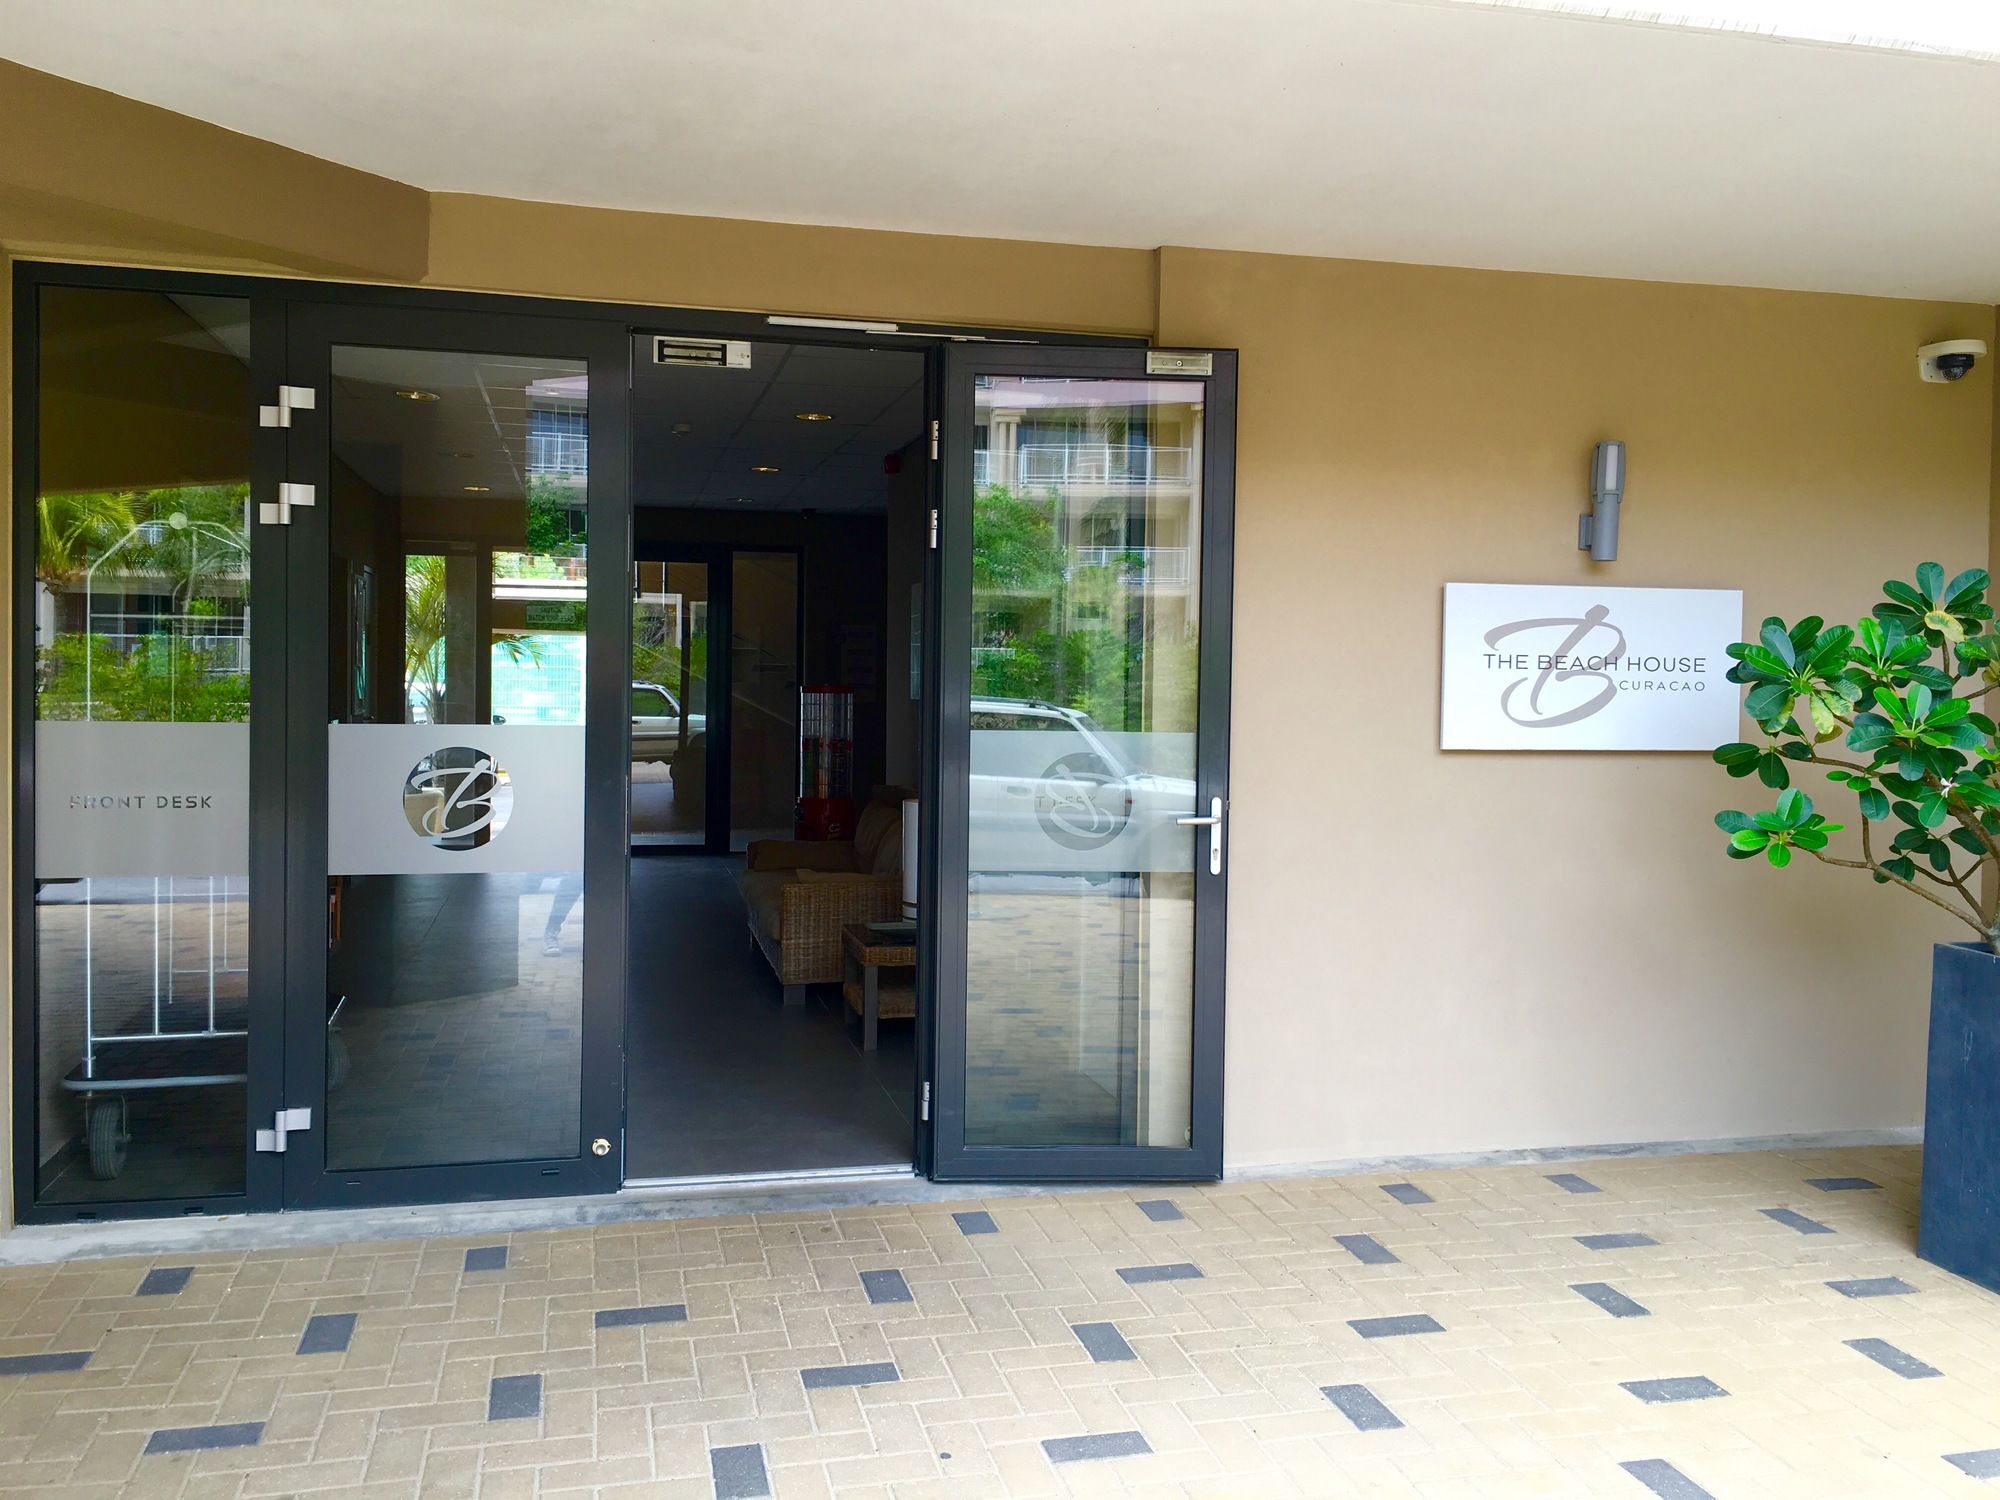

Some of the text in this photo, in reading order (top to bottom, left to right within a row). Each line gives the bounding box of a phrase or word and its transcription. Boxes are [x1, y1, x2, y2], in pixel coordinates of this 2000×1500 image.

[1483, 653, 1707, 673] THE BEACH HOUSE
[1619, 680, 1706, 692] CURACAO
[70, 795, 212, 809] FRONT DESK
